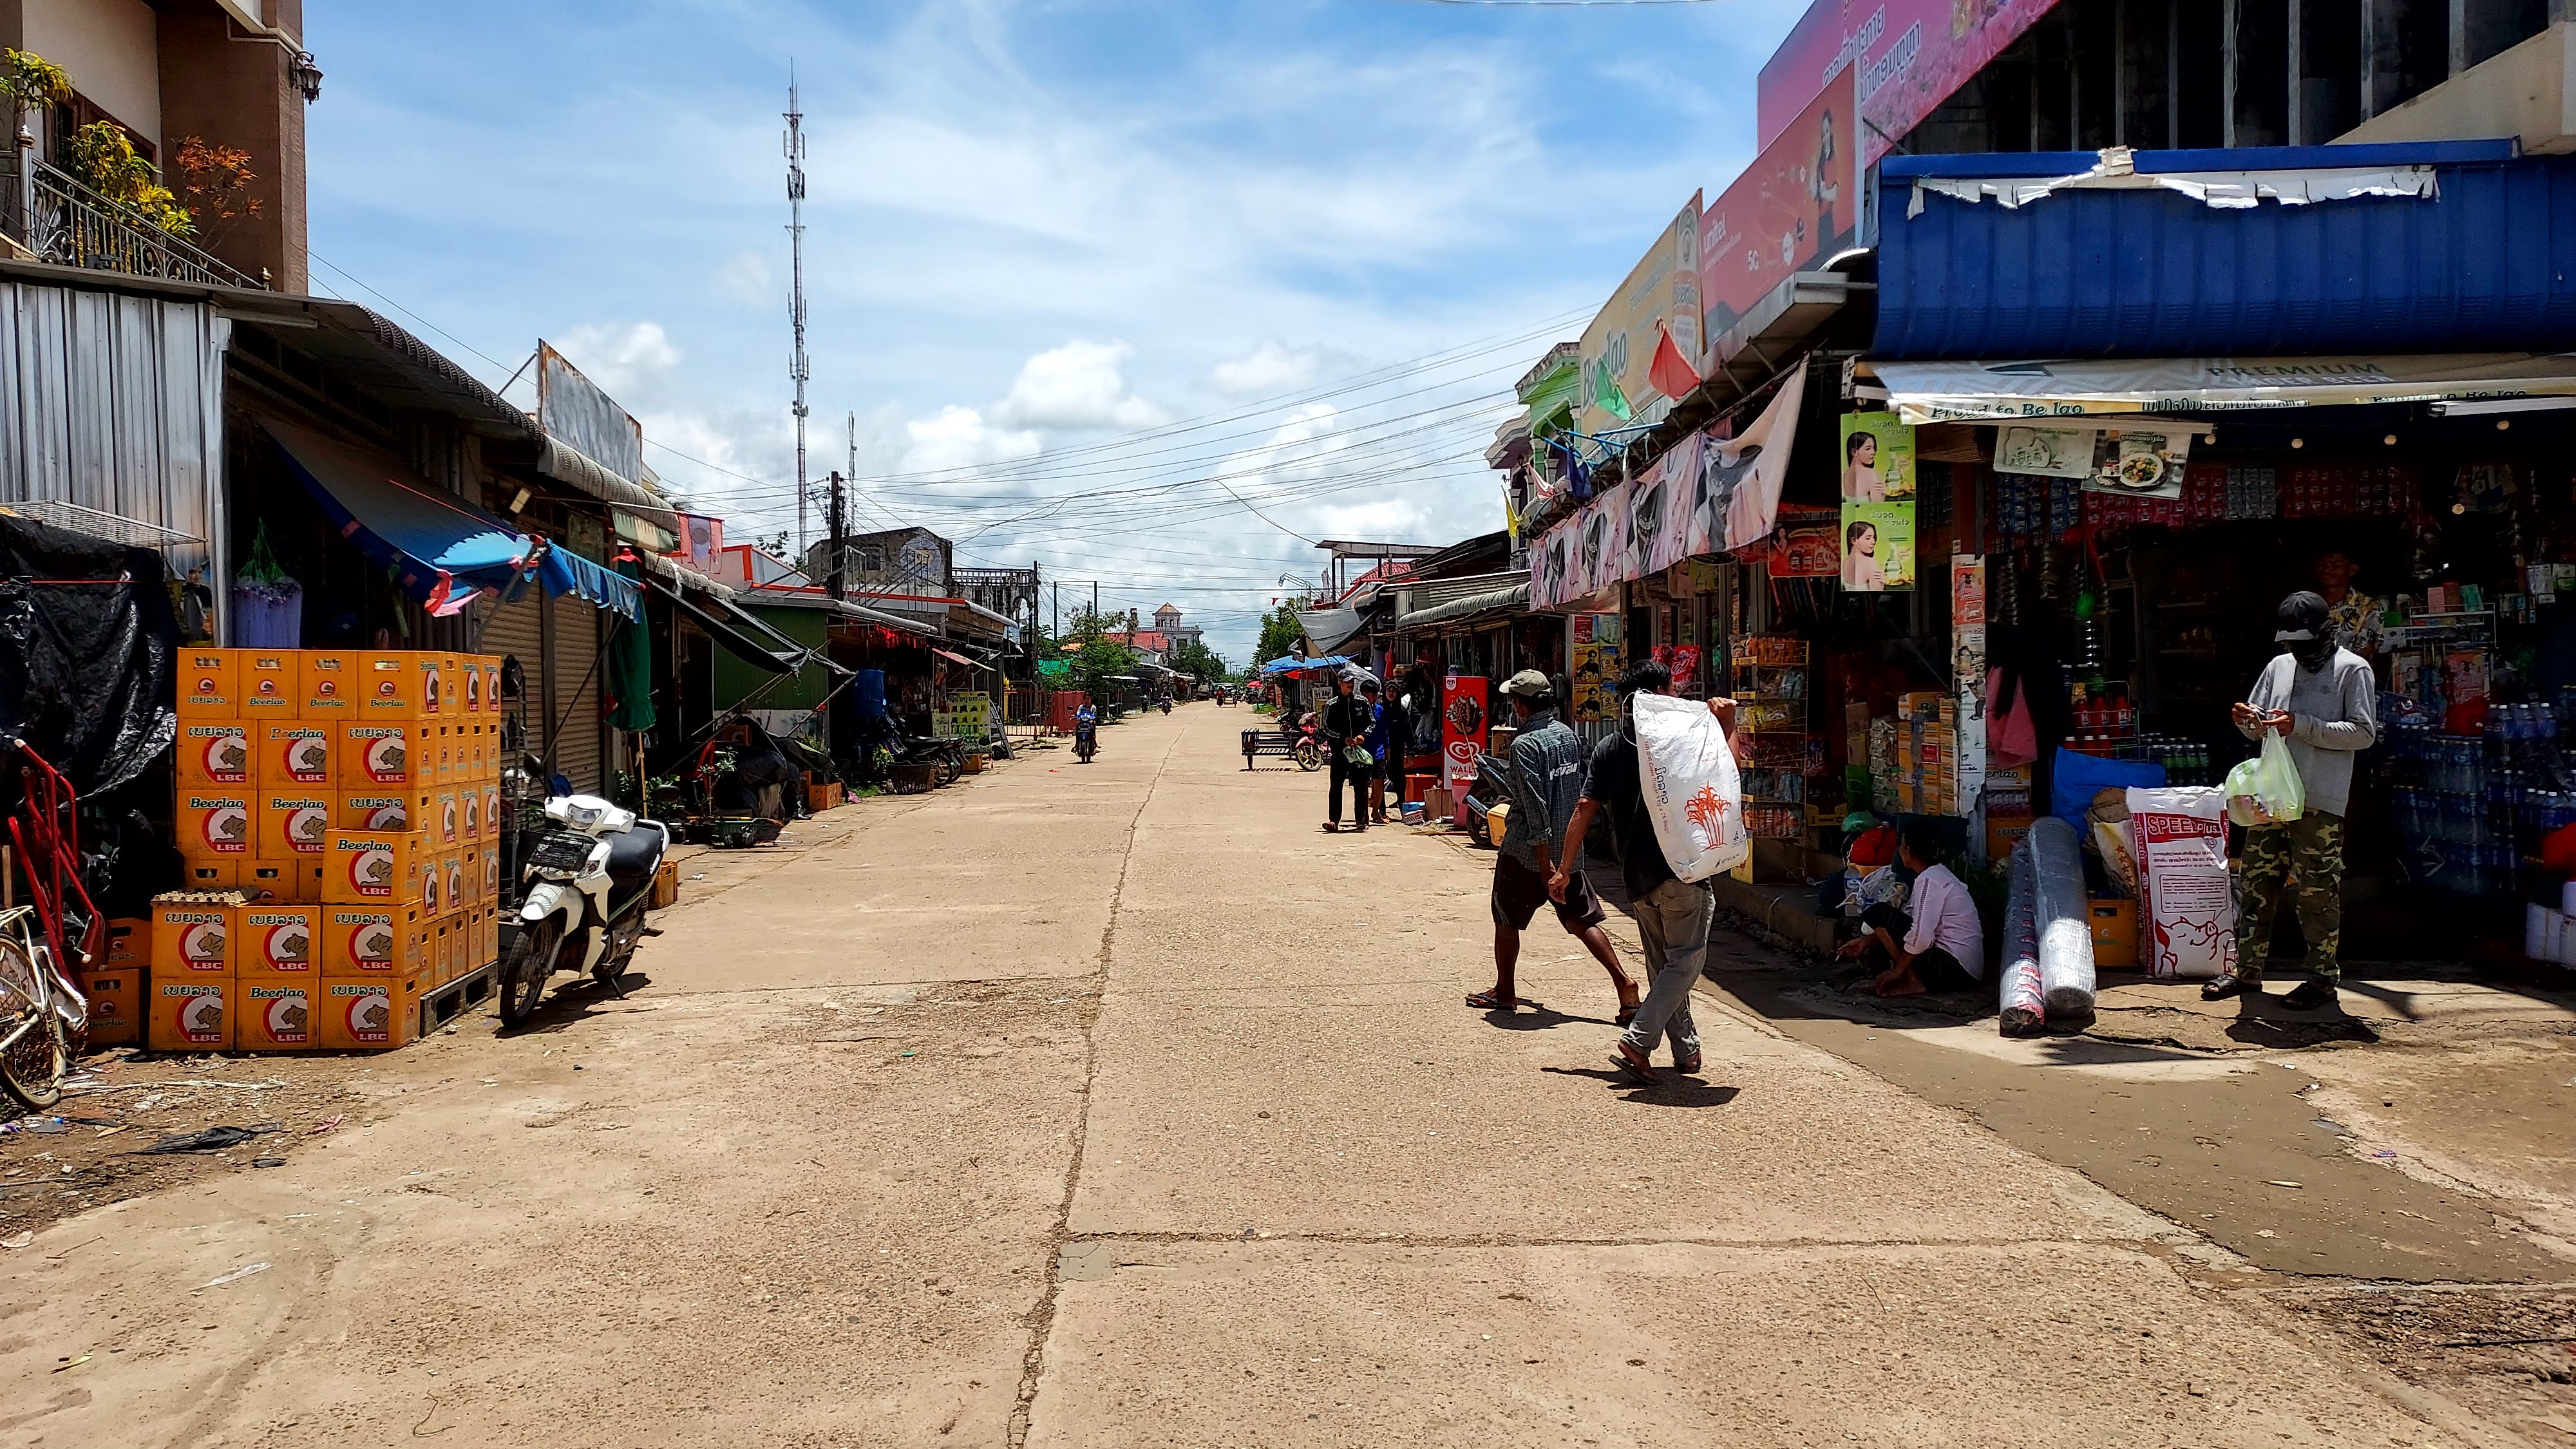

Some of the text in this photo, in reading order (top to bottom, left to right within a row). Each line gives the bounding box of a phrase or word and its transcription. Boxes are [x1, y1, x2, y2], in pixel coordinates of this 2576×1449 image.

[1703, 212, 1726, 253] unitel
[1583, 330, 1629, 411] Belao
[2205, 363, 2384, 377] PREMIUM
[2321, 375, 2394, 384] BEER
[1932, 401, 2085, 419] Proud to Be lao
[188, 696, 226, 705] ເບຍລາວ
[249, 697, 285, 706] Beerlao
[310, 699, 345, 707] Beerlao
[370, 699, 406, 707] Beerlao
[188, 727, 245, 739] ເບຍລາວ
[270, 728, 325, 739] Berlao
[348, 727, 403, 739] ເບຍລາວ
[1450, 765, 1476, 773] WALL
[1986, 769, 2019, 779] erlao
[216, 773, 245, 782] LBC
[297, 773, 325, 782] LBC
[376, 773, 405, 782] LBC
[189, 797, 245, 810] Beerlao
[270, 798, 325, 810] Beerlao
[348, 798, 403, 809] ເບຍລາວ
[2197, 822, 2218, 834] plus
[216, 844, 245, 852] LBC
[297, 844, 325, 852] LBC
[337, 839, 392, 851] Beerlao
[362, 887, 391, 896] LBC
[165, 912, 224, 924] ເບຍລາວ
[249, 913, 307, 925] ເບຍລາວ
[334, 913, 391, 925] ເບຍລາວ
[193, 961, 222, 970] LBC
[278, 962, 308, 971] LBC
[363, 961, 392, 970] LBC
[162, 984, 222, 996] ເບຍລາວ
[249, 987, 305, 999] Beerlao
[331, 985, 387, 996] ເບຍລາວ
[191, 1034, 221, 1043] LBC
[277, 1034, 307, 1043] LBC
[359, 1033, 388, 1041] LBC
